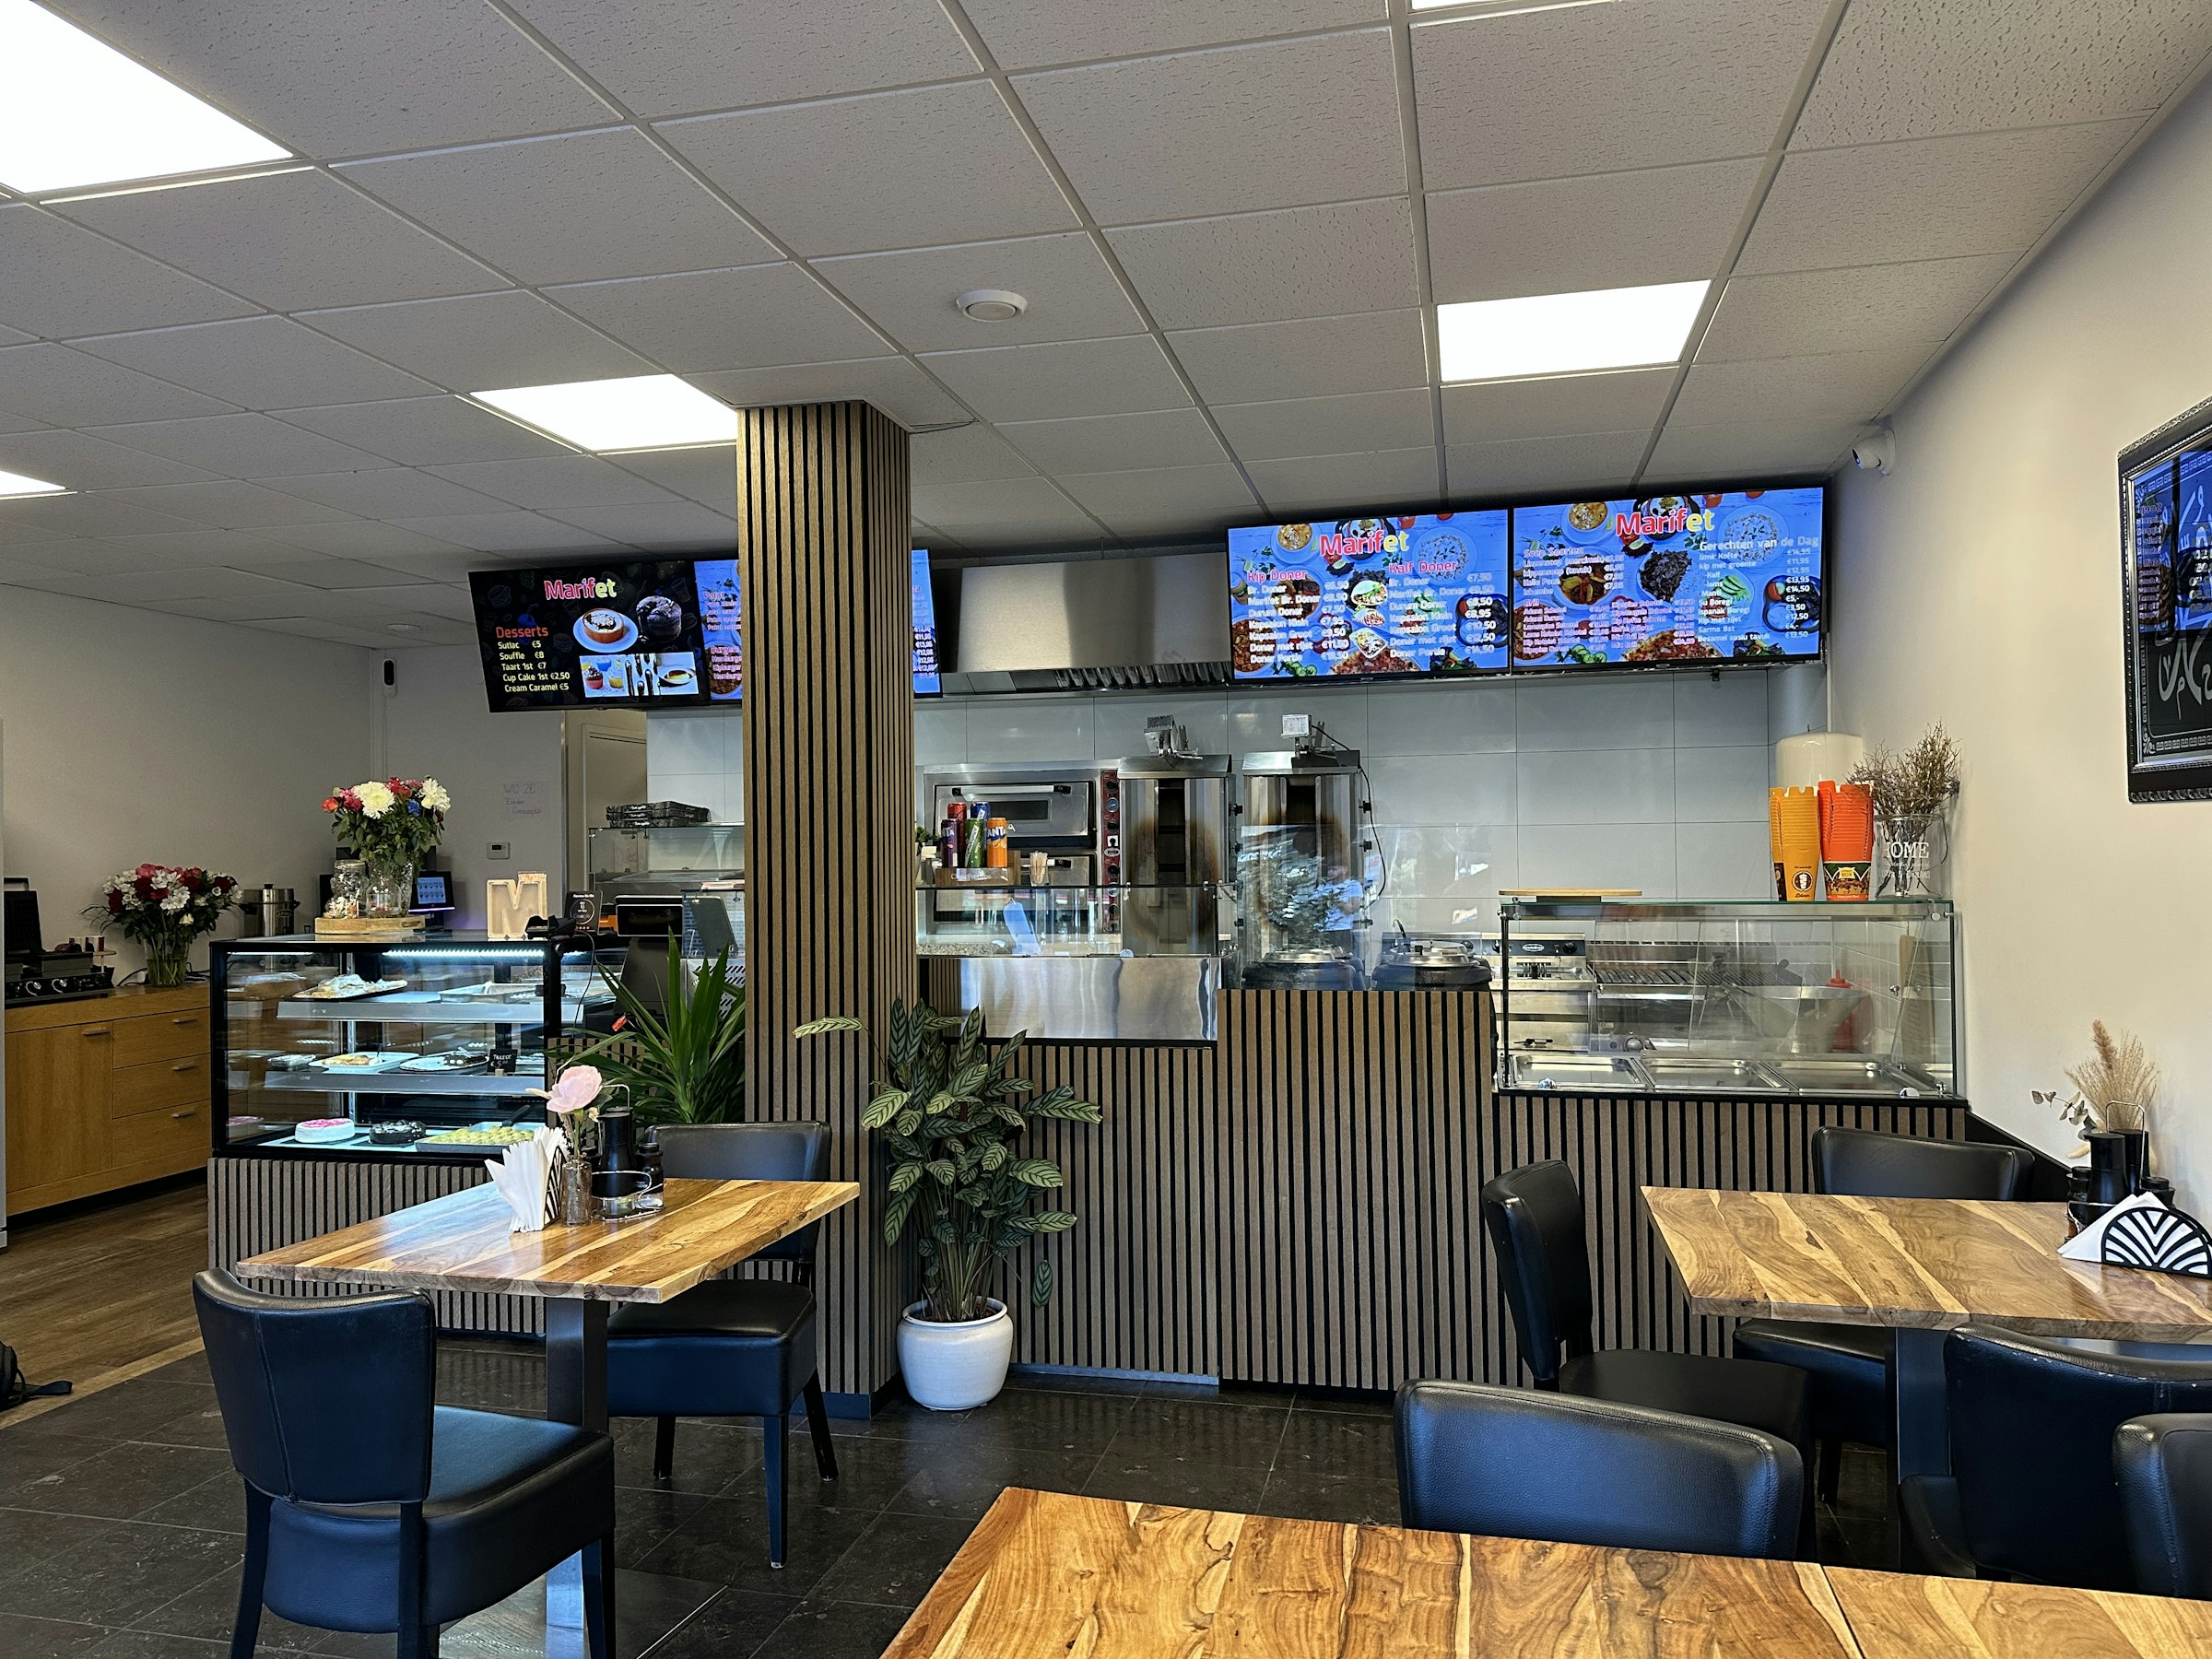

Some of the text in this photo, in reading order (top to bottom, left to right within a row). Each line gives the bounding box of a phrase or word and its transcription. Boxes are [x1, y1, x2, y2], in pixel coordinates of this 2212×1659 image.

[1615, 508, 1715, 536] Marifet
[1320, 530, 1408, 557] Marifet
[1699, 536, 1819, 551] Gerechten van de Dag
[1388, 561, 1458, 574] Kalf Doner
[1728, 560, 1757, 570] groente
[1247, 570, 1308, 583] Kip Doner
[544, 577, 617, 600] Marifet
[1262, 584, 1288, 594] Doner
[1786, 584, 1810, 593] €14,50
[1296, 594, 1321, 604] Doner
[1785, 594, 1799, 603] €5,-
[1277, 607, 1303, 616] Doner
[496, 626, 548, 639] Desserts
[498, 641, 520, 650] Sutlac
[1250, 643, 1276, 653] Doner
[500, 652, 524, 660] Souffle
[1390, 649, 1417, 658] Doner
[1250, 655, 1276, 664] Doner
[501, 663, 520, 671] Taart
[522, 662, 533, 670] 1st
[502, 674, 516, 683] Cup
[518, 673, 535, 681] Cake
[550, 672, 570, 681] €2,50
[504, 683, 569, 692] Cream Caramel €5
[1883, 841, 1930, 858] HOME
